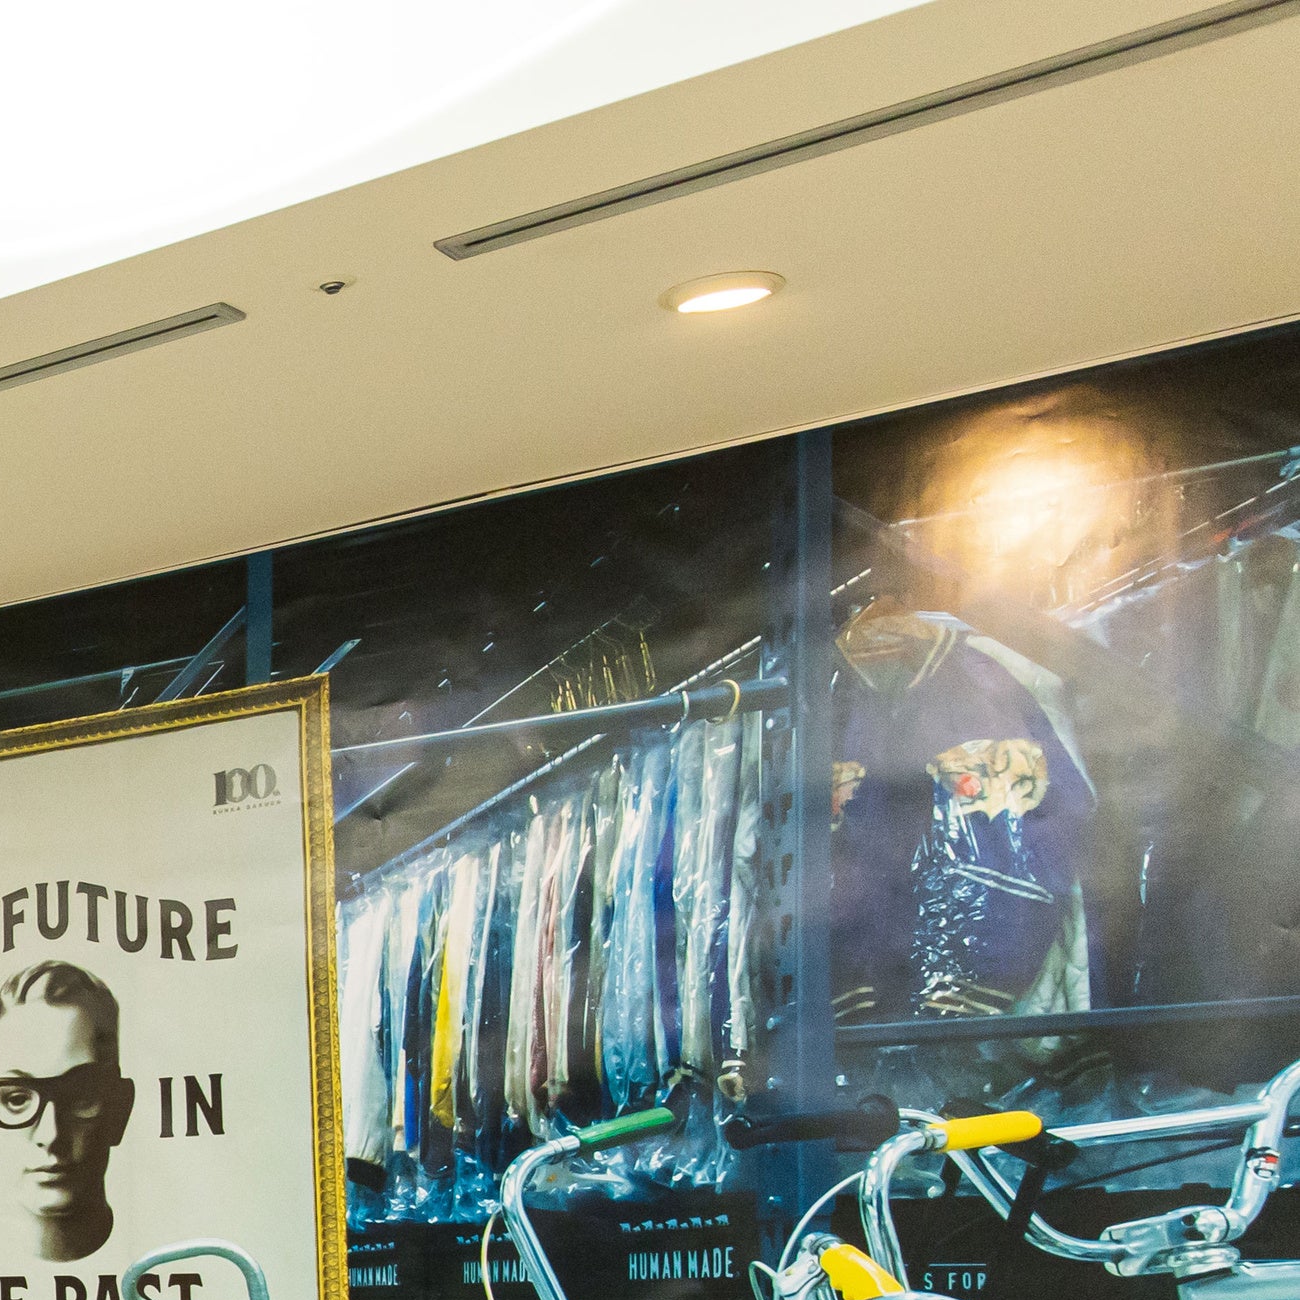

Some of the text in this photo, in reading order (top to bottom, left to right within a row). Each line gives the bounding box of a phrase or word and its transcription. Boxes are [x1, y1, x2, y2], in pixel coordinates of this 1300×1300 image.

[2, 879, 239, 961] FUTURE
[158, 1073, 226, 1138] IN
[376, 1264, 398, 1286] MADE
[464, 1260, 531, 1284] HUMN MAD
[628, 1246, 734, 1280] HUMAN MADE
